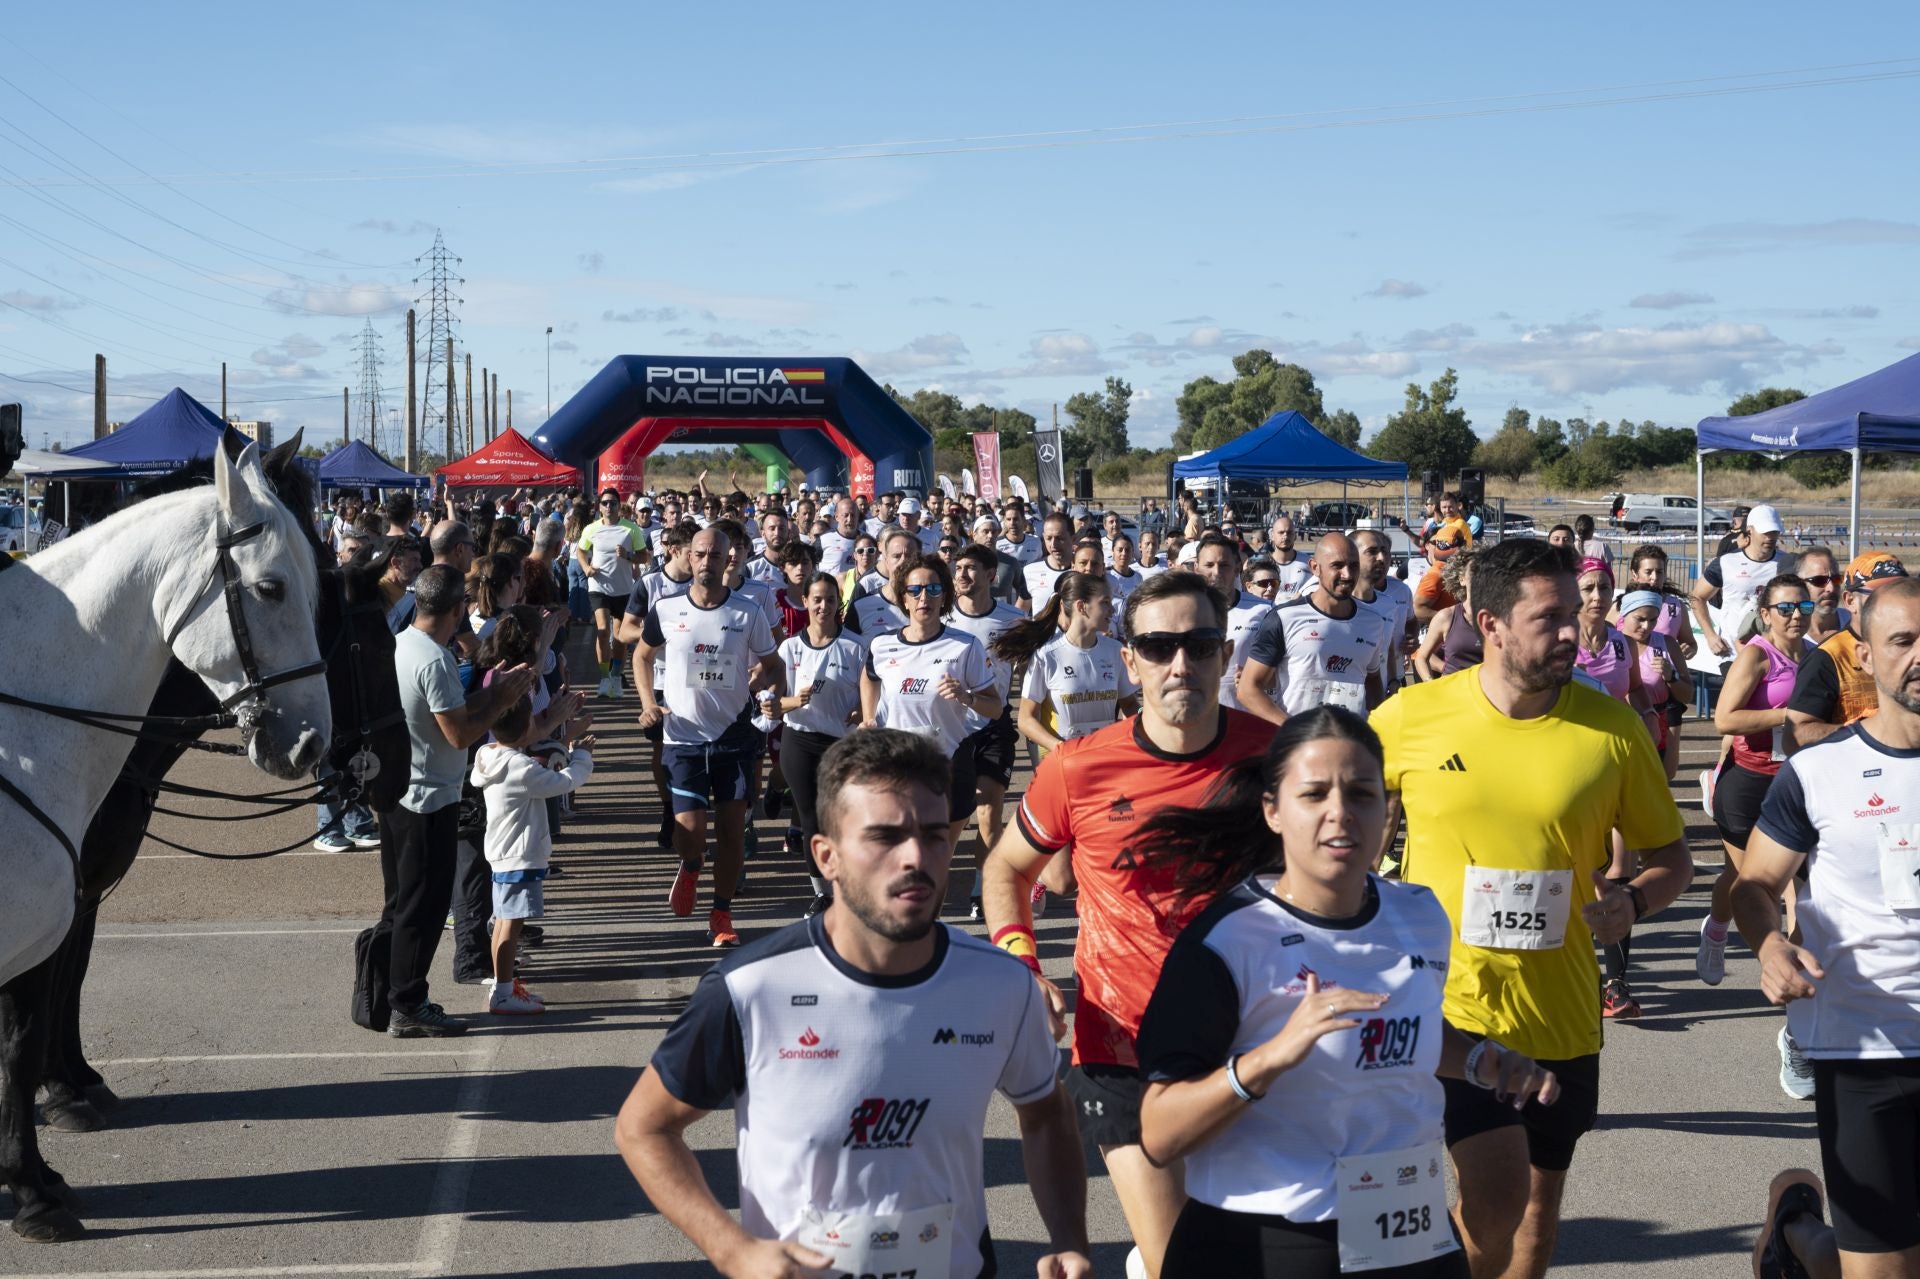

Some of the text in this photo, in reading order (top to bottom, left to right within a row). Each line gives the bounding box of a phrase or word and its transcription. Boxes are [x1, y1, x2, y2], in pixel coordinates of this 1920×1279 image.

[646, 387, 825, 404] NACIONAL
[493, 450, 524, 458] Sports
[120, 461, 171, 470] Ayuntamiento
[489, 458, 539, 467] Santander
[894, 469, 921, 487] RUTA
[699, 672, 724, 681] 1514
[1854, 805, 1901, 819] Santander
[1491, 911, 1546, 930] 1525
[961, 1031, 995, 1047] mupol
[778, 1048, 840, 1060] Santander
[1348, 1182, 1384, 1192] Santander
[1375, 1204, 1431, 1239] 1258
